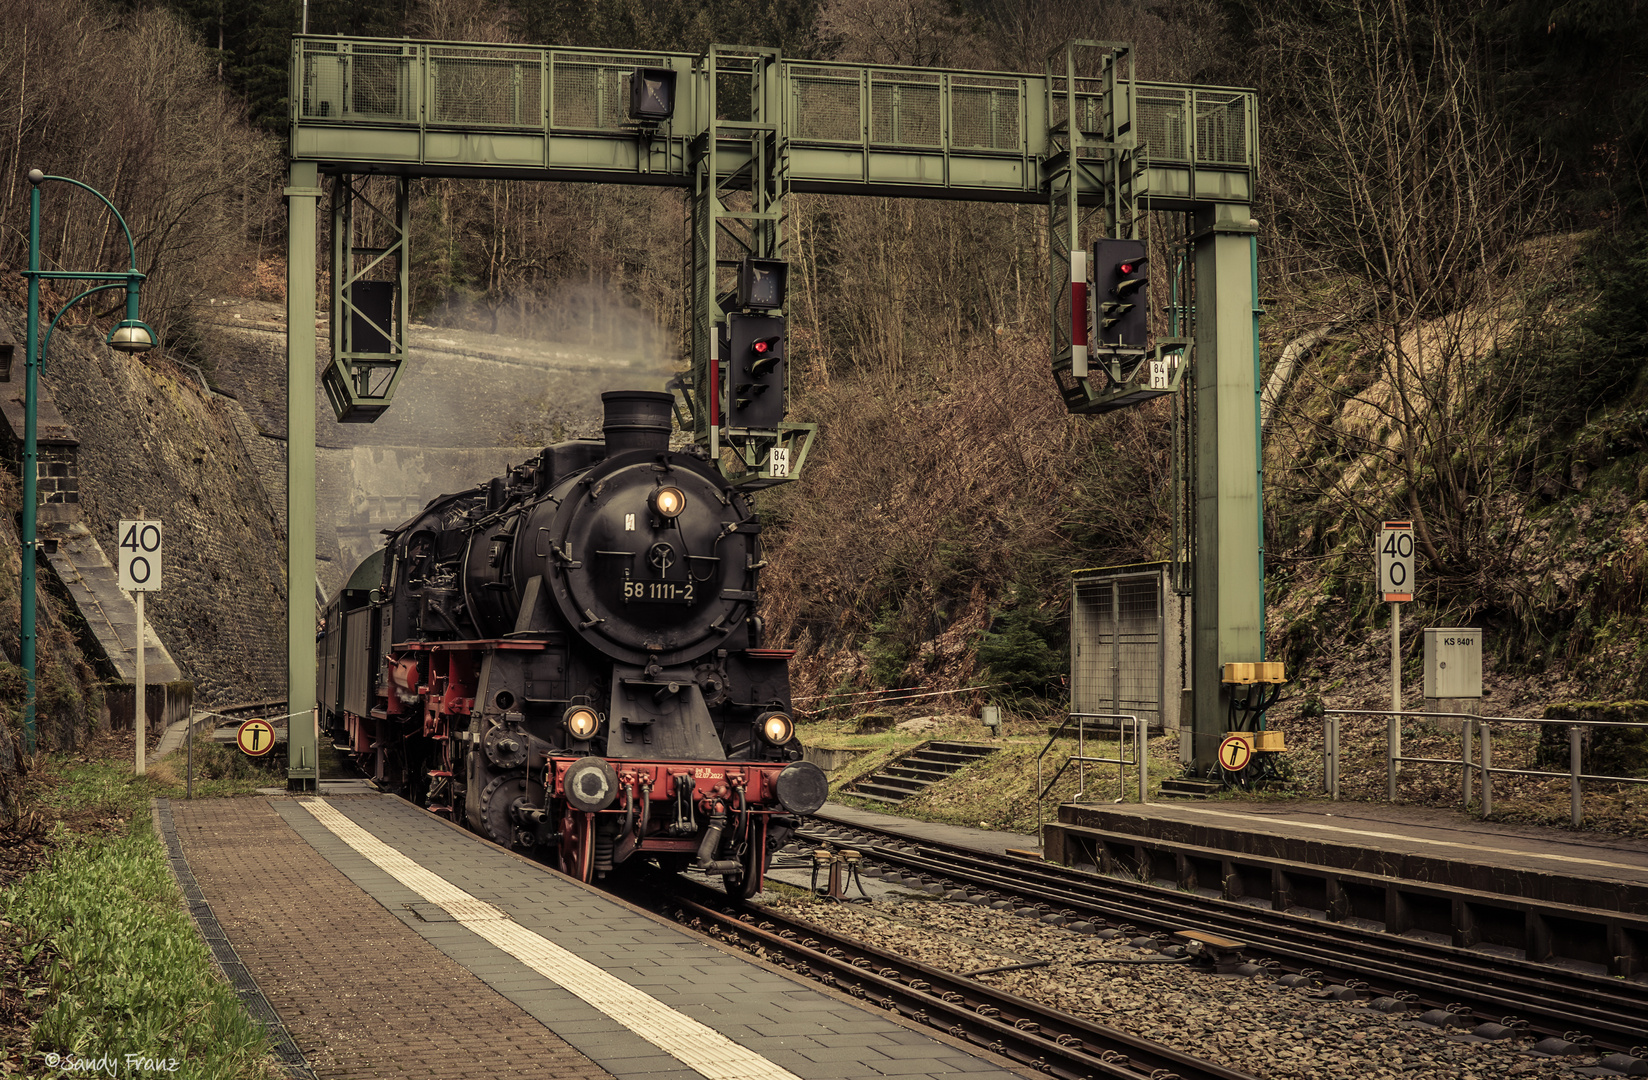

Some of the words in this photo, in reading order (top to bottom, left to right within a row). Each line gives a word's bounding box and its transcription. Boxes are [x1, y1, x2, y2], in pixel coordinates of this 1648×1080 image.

[1154, 364, 1164, 374] 84
[1155, 377, 1164, 388] P1
[774, 451, 785, 461] 84
[774, 464, 785, 477] P2
[120, 525, 160, 552] 40
[1382, 534, 1413, 558] 40
[624, 582, 644, 598] 58
[649, 583, 693, 600] 1111-2
[1444, 638, 1455, 646] KS
[1457, 638, 1474, 646] 8401
